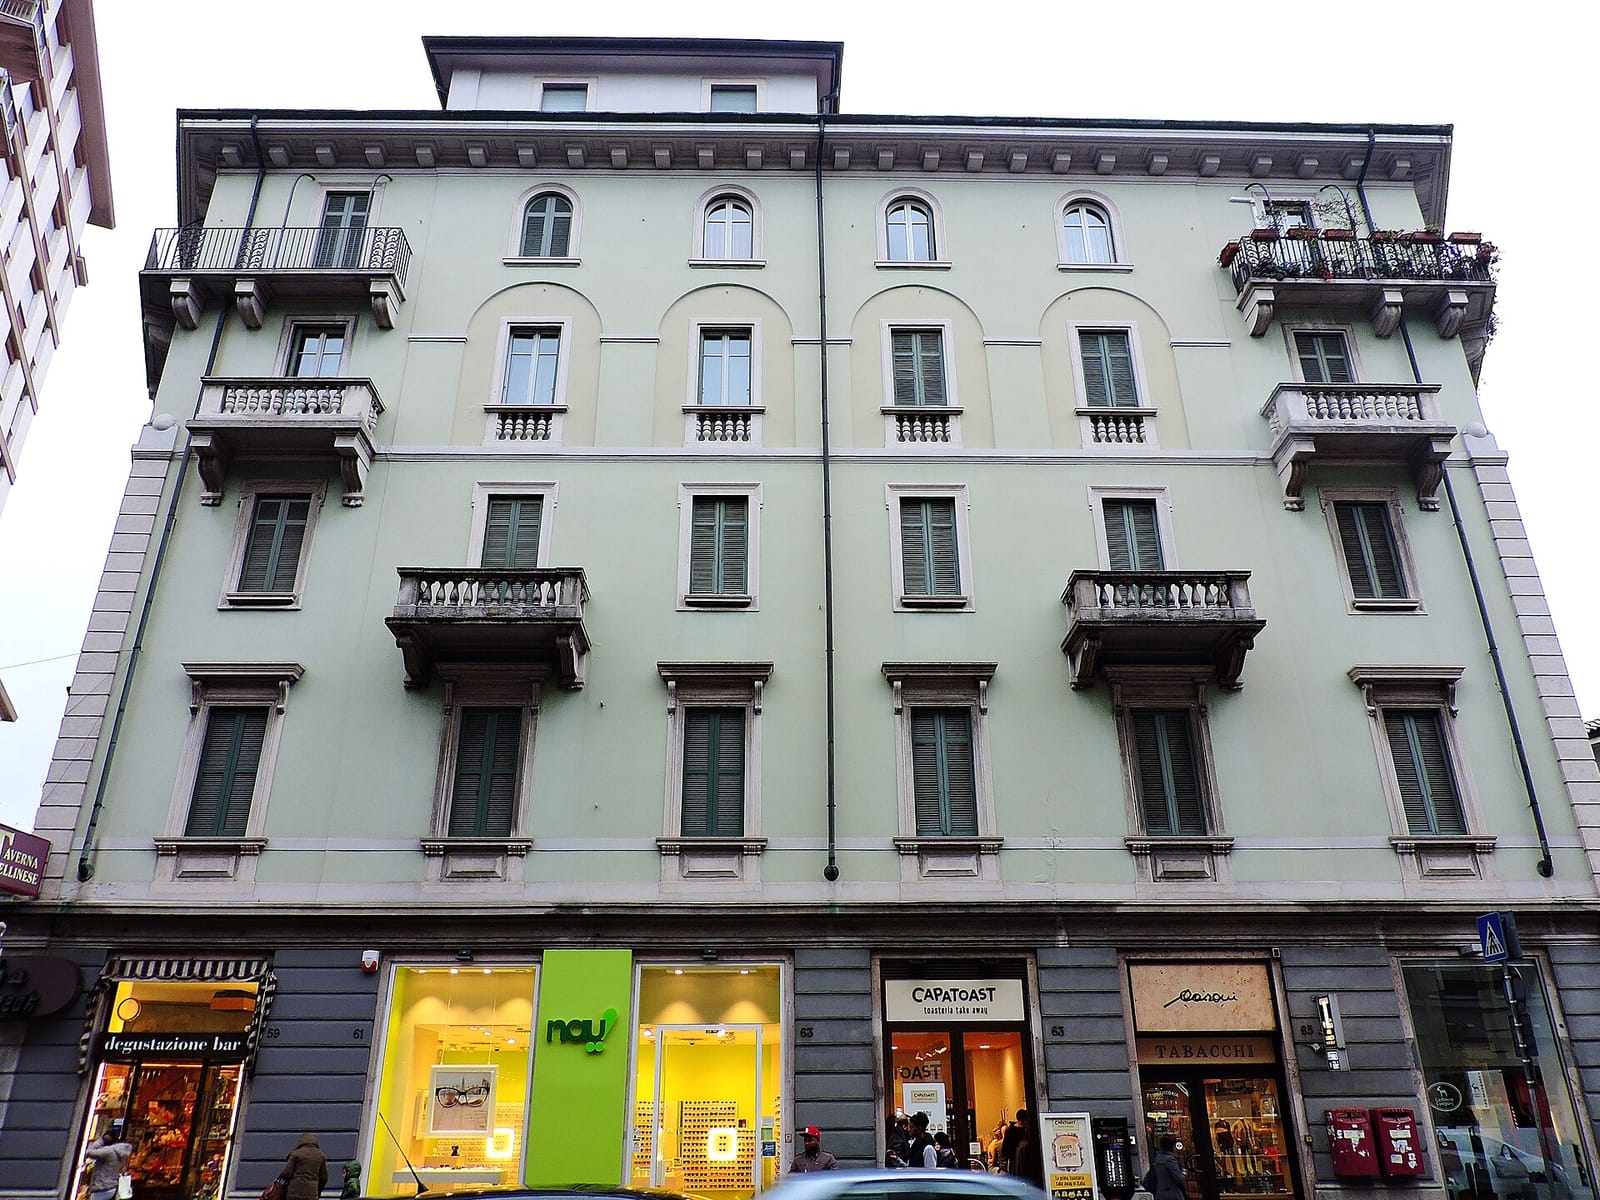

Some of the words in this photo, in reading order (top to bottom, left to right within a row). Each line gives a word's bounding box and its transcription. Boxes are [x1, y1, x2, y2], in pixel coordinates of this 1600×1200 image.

[912, 987, 996, 1003] CAPATOAST
[923, 1006, 954, 1015] toasteria
[956, 1007, 970, 1015] take
[972, 1007, 988, 1016] away
[267, 1029, 280, 1039] 59
[105, 1037, 207, 1055] degustazione
[213, 1036, 241, 1052] bar
[1155, 1045, 1255, 1058] TABACCHI
